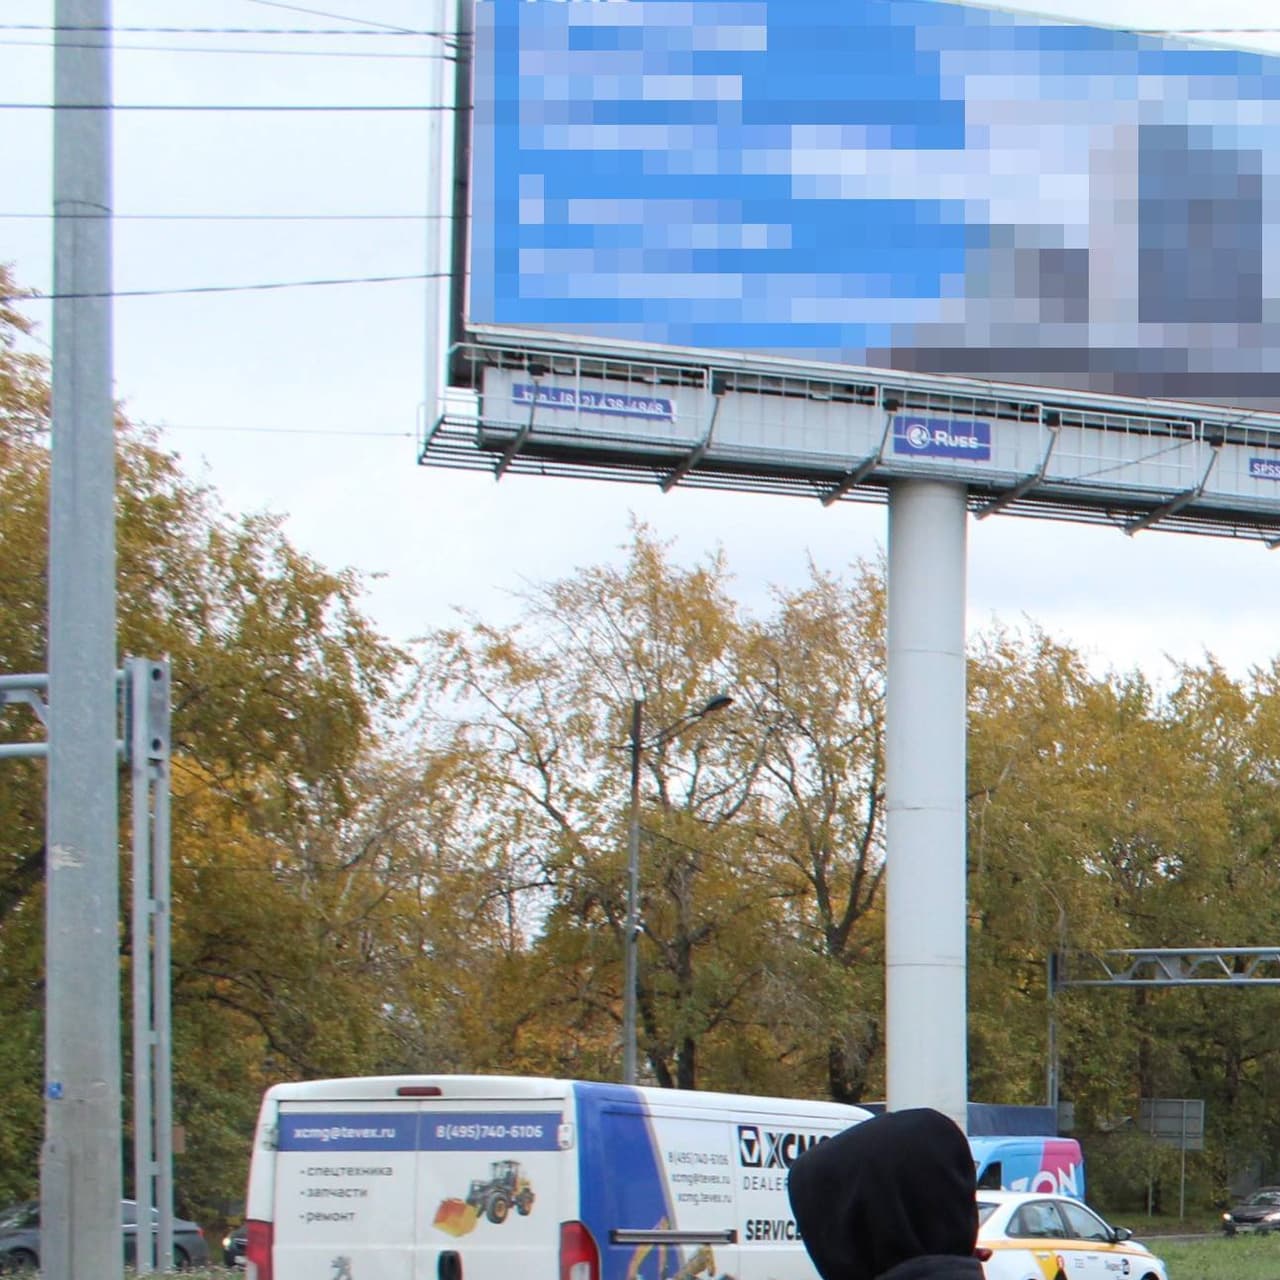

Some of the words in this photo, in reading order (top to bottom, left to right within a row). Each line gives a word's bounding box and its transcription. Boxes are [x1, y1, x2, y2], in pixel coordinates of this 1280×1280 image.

[934, 430, 978, 448] Russ
[294, 1126, 396, 1142] xcmg@tevex.ru
[436, 1124, 544, 1140] 8(495)740-6106
[764, 1132, 832, 1168] XC
[307, 1211, 355, 1223] ремонт
